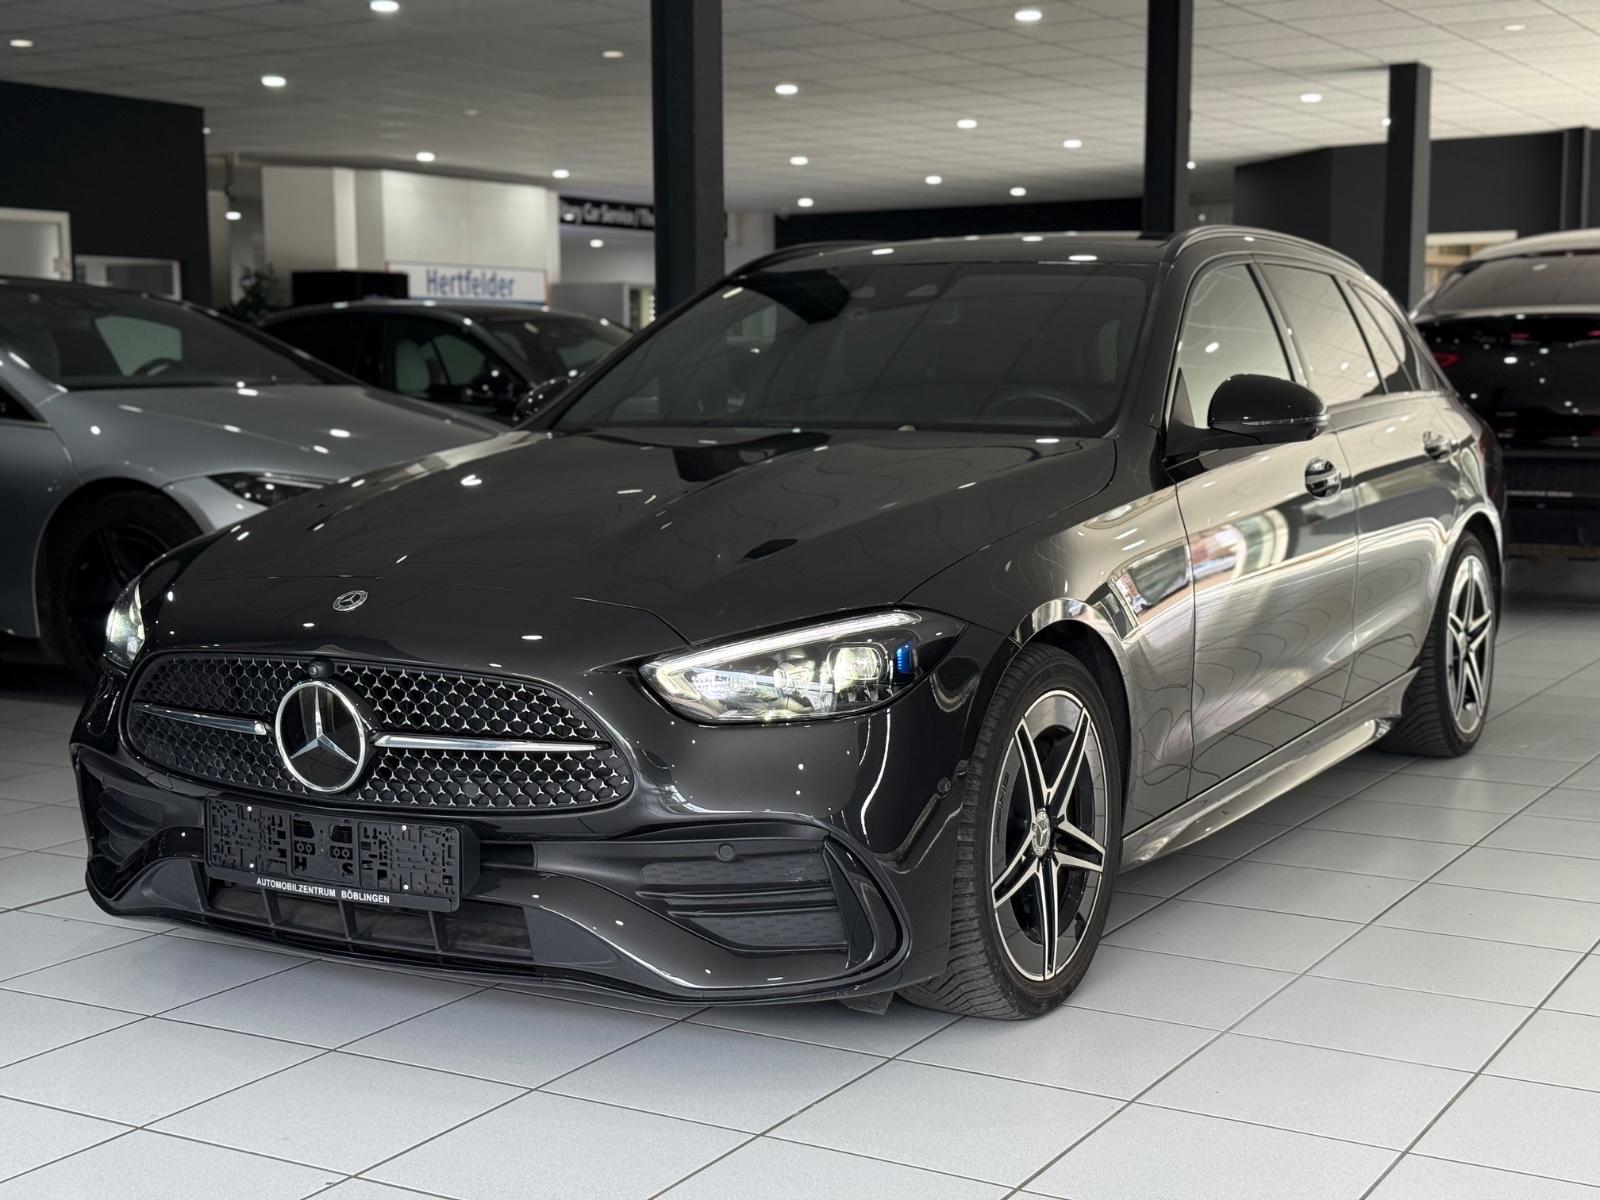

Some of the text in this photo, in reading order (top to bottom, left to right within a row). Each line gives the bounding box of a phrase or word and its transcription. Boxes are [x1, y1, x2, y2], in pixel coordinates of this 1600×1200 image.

[426, 269, 515, 297] Hertfelder
[256, 877, 390, 904] AUTOMOBILZENTRUM BÖBLINGEN
